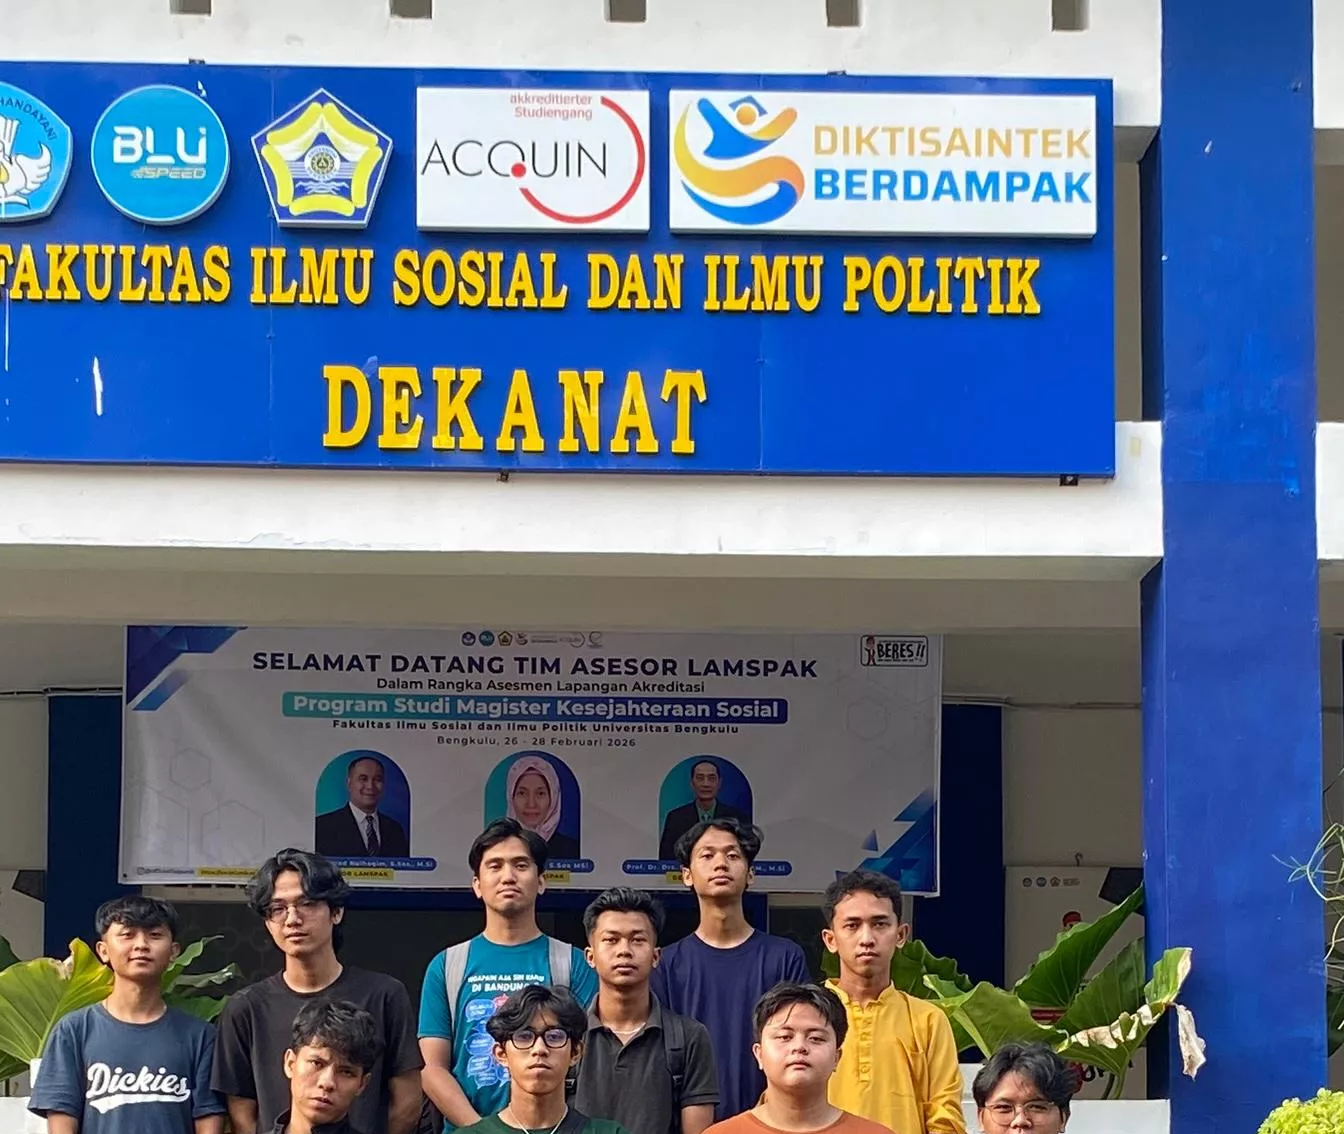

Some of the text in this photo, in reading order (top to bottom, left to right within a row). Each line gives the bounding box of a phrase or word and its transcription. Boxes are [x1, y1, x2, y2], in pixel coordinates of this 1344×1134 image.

[510, 93, 592, 105] akkreditierter
[515, 107, 592, 120] Studiengang
[113, 126, 206, 164] BLU
[814, 126, 1092, 159] DIKTISAINTEK
[421, 140, 606, 178] ACQUIN
[142, 166, 206, 179] SPEED
[814, 168, 1091, 203] BERDAMPAK
[250, 245, 374, 308] ILMU
[392, 249, 569, 311] SOSIAL
[587, 252, 685, 311] DAN
[704, 254, 824, 313] ILMU
[843, 255, 1043, 316] POLITIK
[322, 364, 708, 456] DEKANAT
[253, 653, 817, 677] SELAMAT DATANG TIM ASESOR LAMSPAK
[377, 678, 705, 693] Dalam Rangka Asesmen Lapangan Akreditasi
[293, 696, 778, 719] Program Studi Magister Kesejahteraan Sosial
[333, 720, 738, 735] Fakultas Ilmu Sosial dan Ilmu Politik Universitas Bengkulu
[437, 736, 500, 746] Bengkulu,
[504, 737, 518, 745] 26
[532, 738, 546, 746] 28
[551, 737, 602, 747] Februari
[607, 738, 636, 747] 2026
[472, 983, 481, 992] DI
[85, 1062, 191, 1101] Dickies
